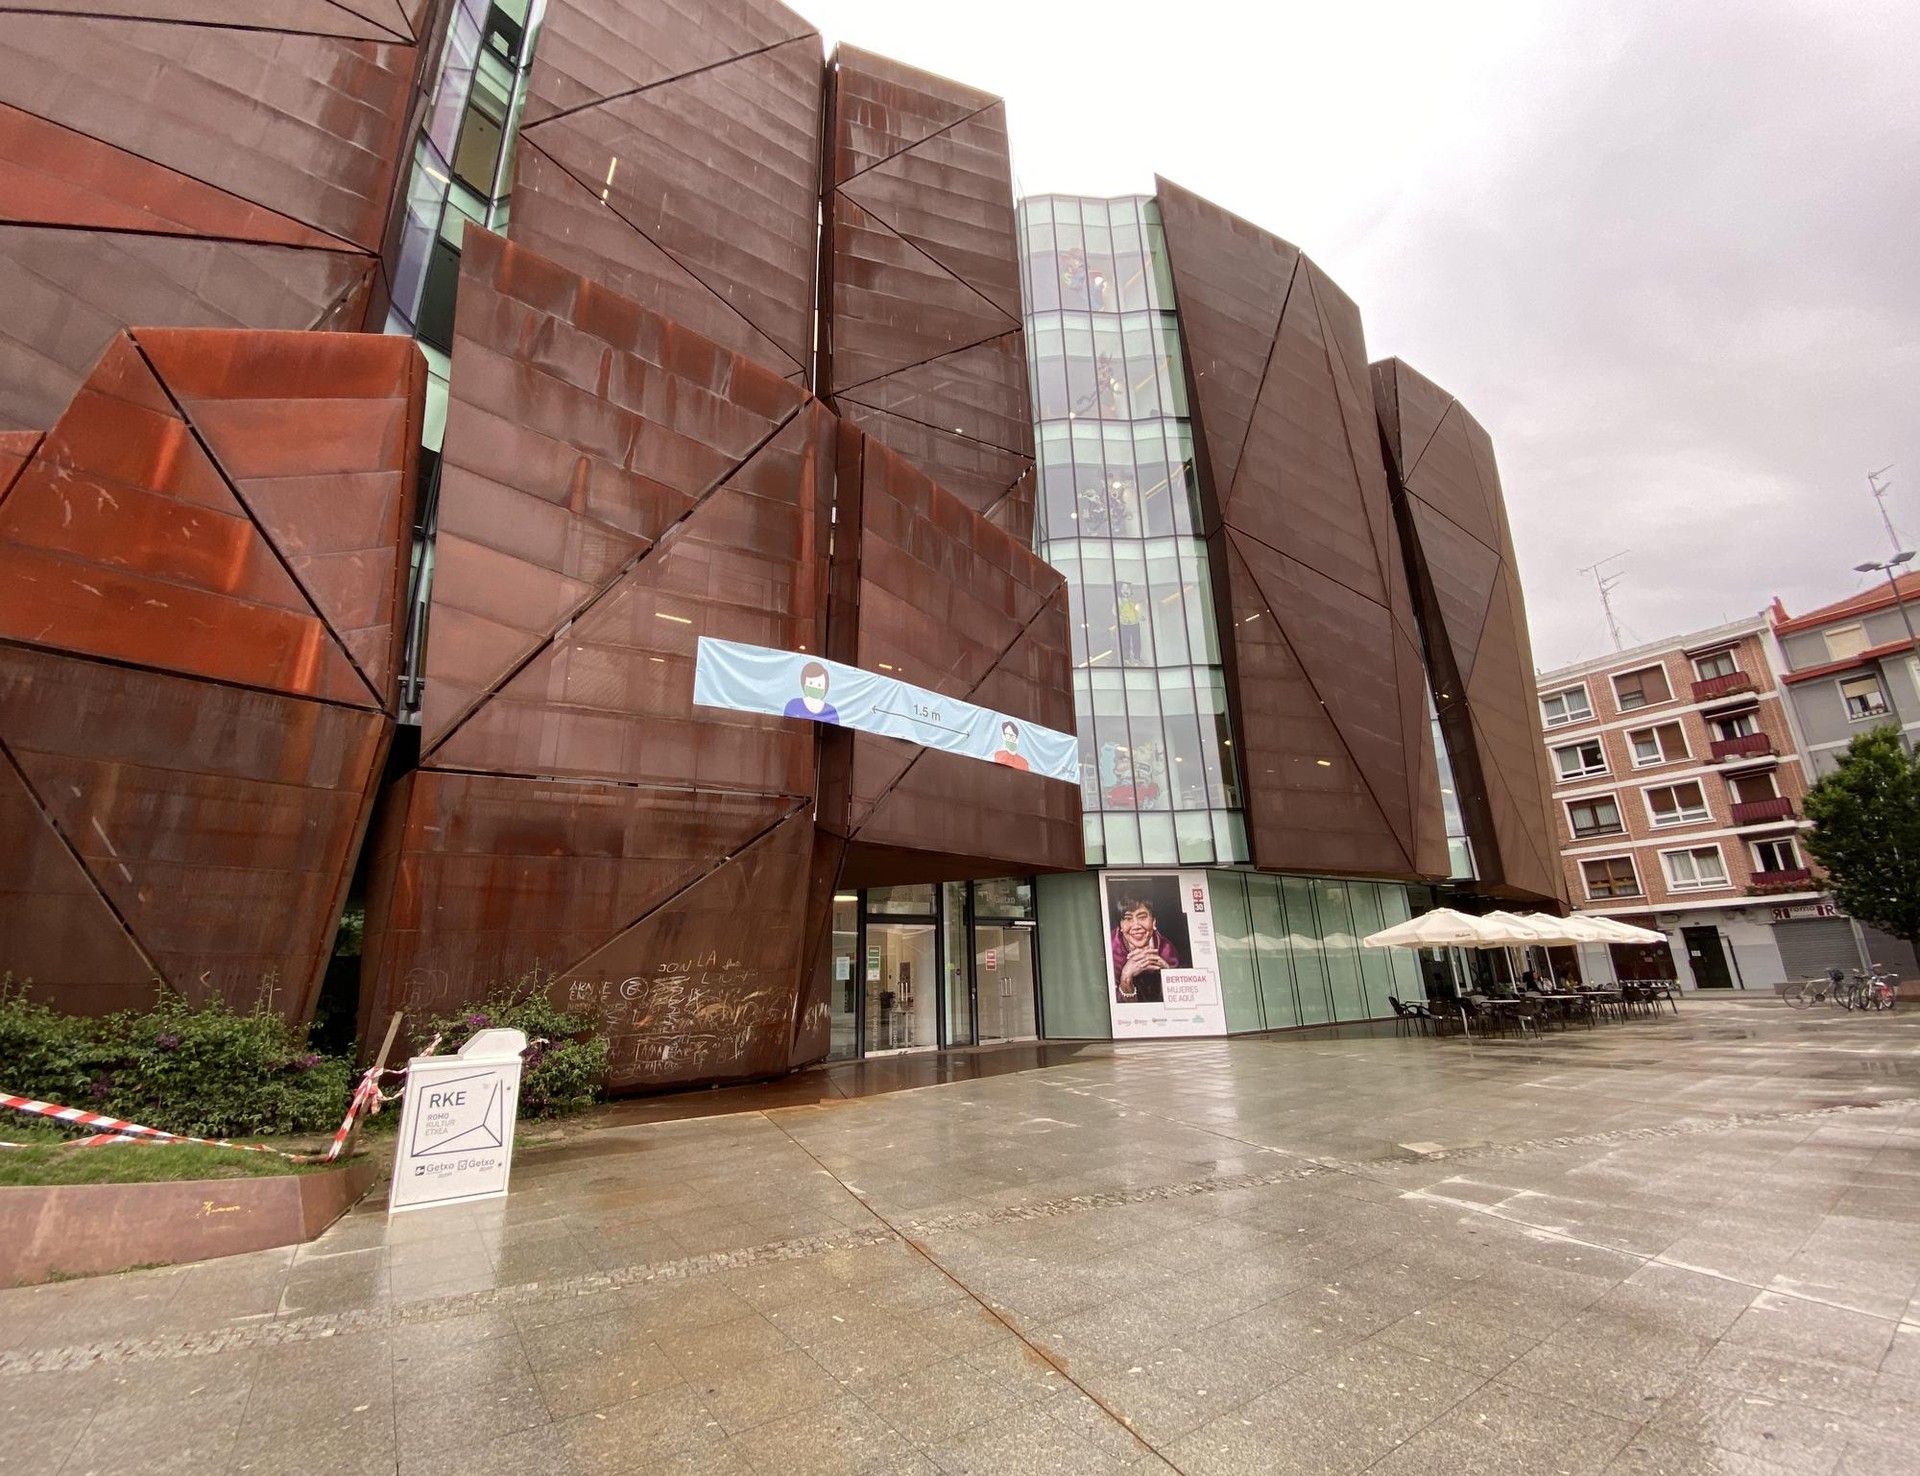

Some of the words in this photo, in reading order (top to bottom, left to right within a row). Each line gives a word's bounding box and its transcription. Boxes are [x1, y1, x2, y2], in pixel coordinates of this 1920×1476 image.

[914, 704, 928, 717] 1.5
[931, 711, 941, 721] m
[1165, 975, 1207, 984] BERTOKOAK
[1166, 985, 1199, 994] MUJERES
[429, 1091, 467, 1108] RKE
[426, 1119, 456, 1128] KULTUR
[425, 1128, 449, 1136] ETXEA
[426, 1162, 455, 1172] Getxo
[468, 1159, 495, 1168] Getxo
